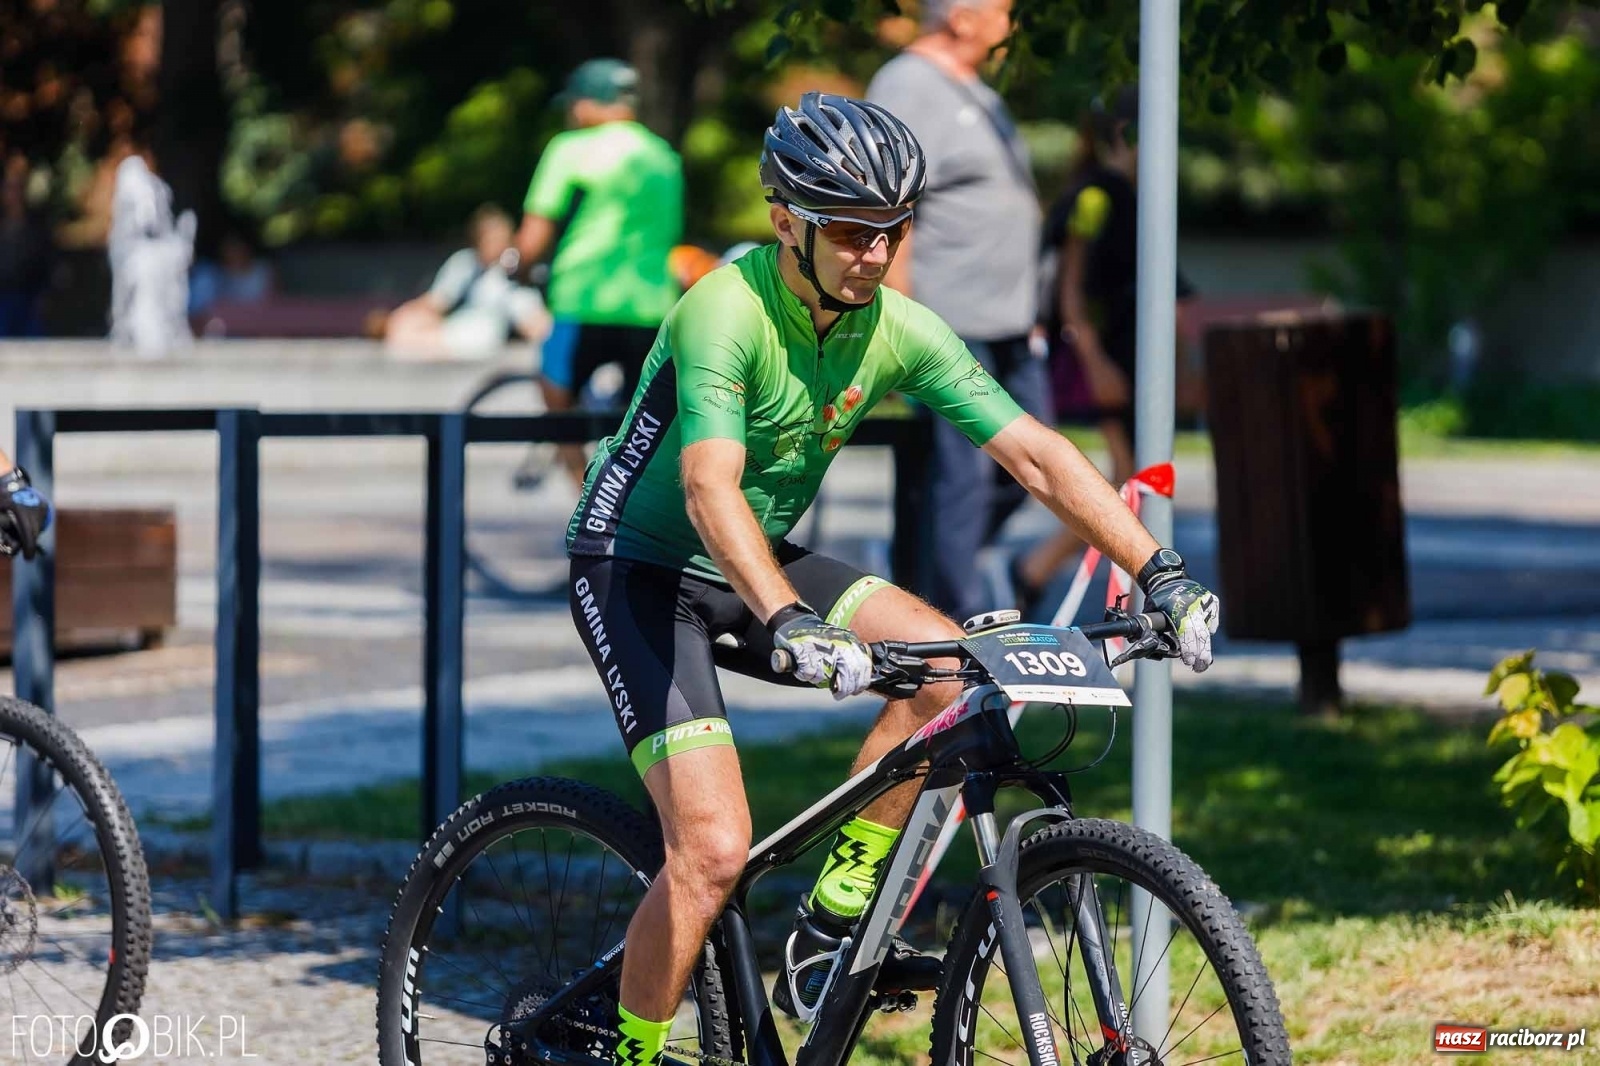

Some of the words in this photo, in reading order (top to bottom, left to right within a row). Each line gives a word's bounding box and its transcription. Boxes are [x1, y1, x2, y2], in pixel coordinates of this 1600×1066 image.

[586, 462, 633, 534] GMINA
[620, 411, 662, 469] LYSKI
[575, 576, 612, 664] GMINA
[606, 664, 638, 735] LYSKI
[1004, 651, 1087, 678] 1309
[502, 802, 577, 819] ROCKET
